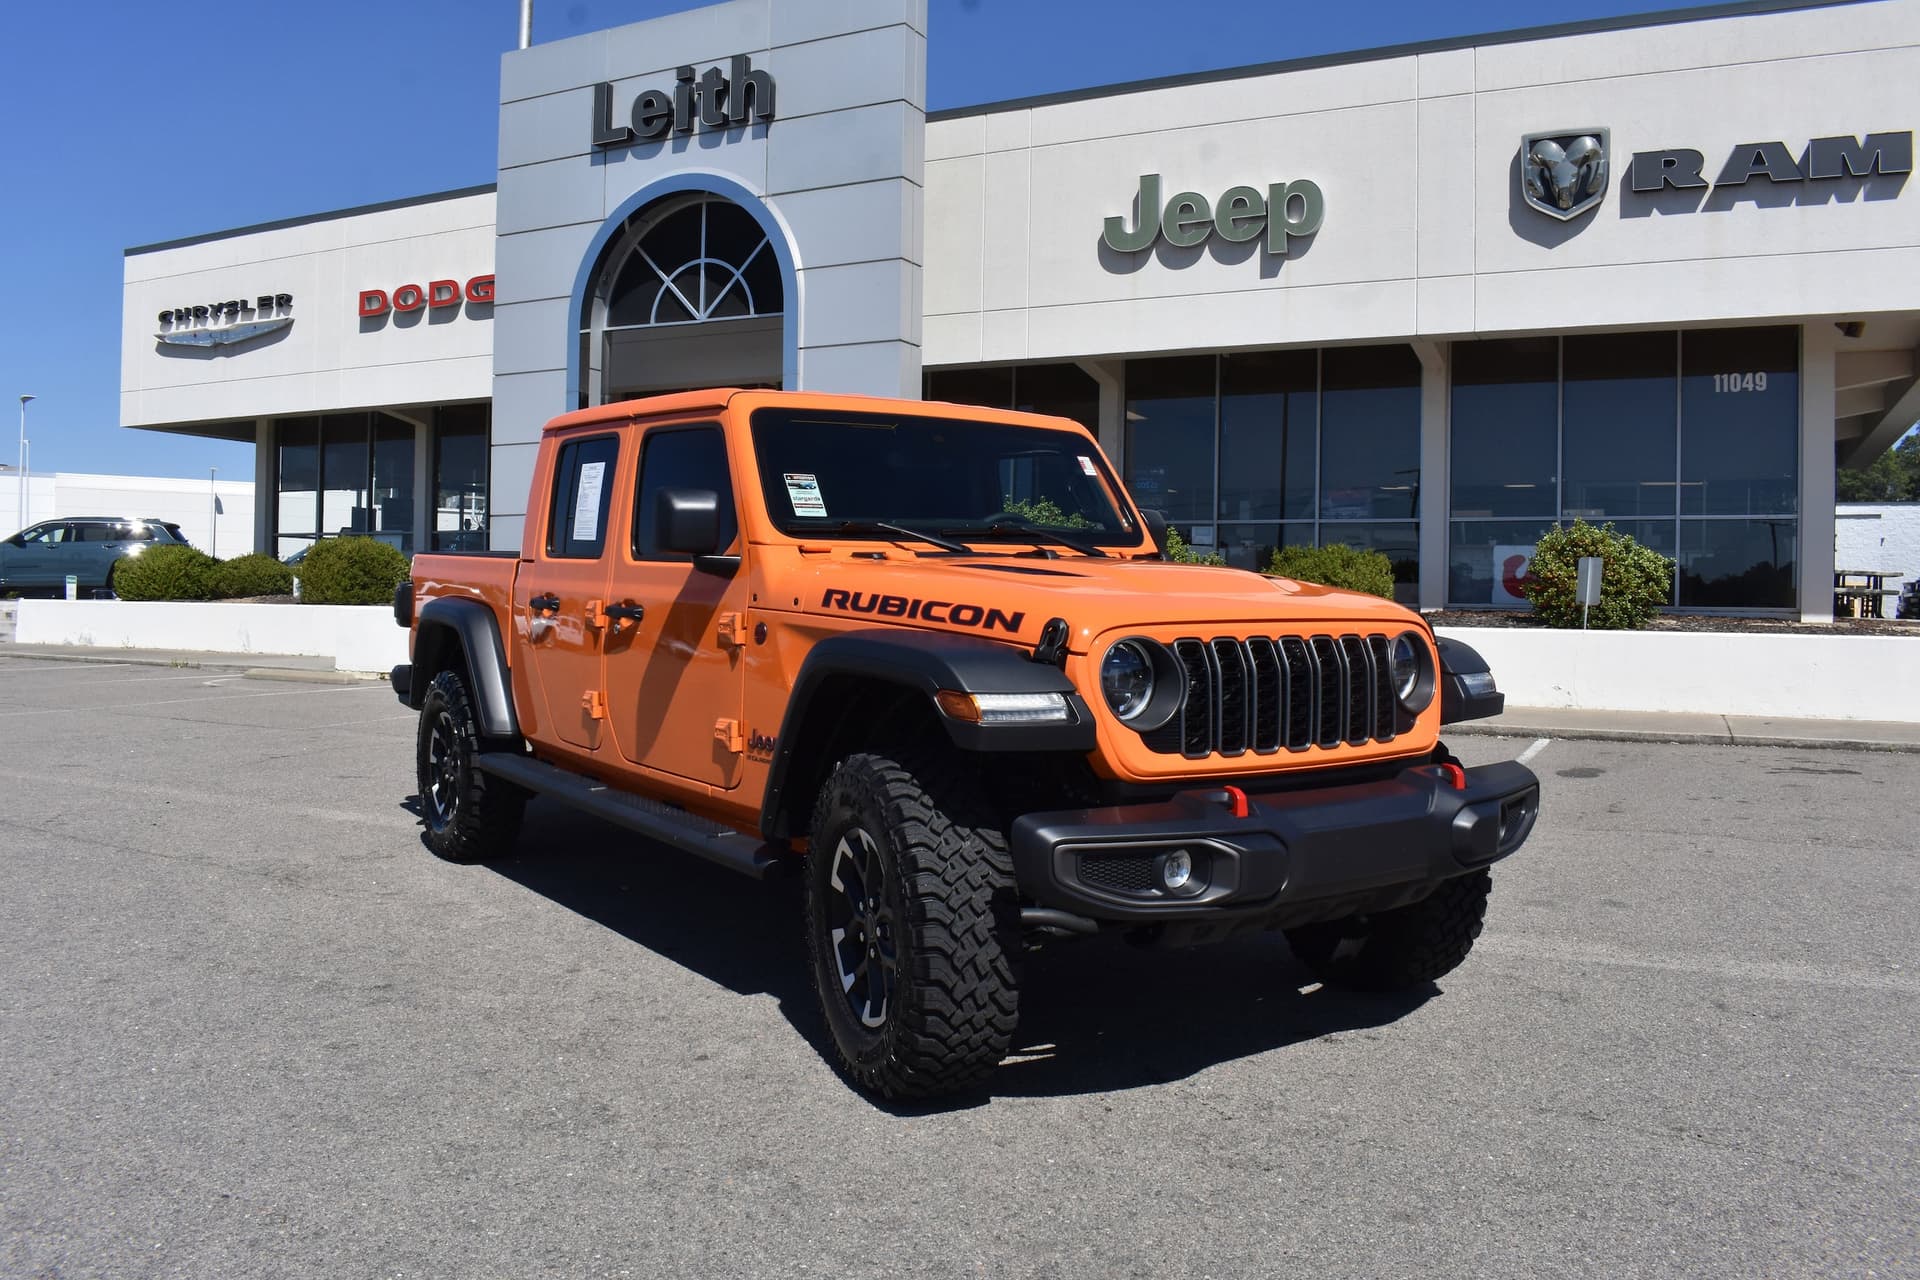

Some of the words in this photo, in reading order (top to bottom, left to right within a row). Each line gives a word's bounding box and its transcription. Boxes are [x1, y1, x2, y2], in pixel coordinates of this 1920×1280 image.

[592, 54, 775, 145] Leith
[1631, 130, 1914, 192] RAM
[1103, 174, 1324, 254] Jeep
[158, 293, 293, 323] CHRYSLER
[359, 274, 495, 317] DODG
[1713, 371, 1767, 393] 11049
[821, 588, 1026, 634] RUBICON
[748, 728, 777, 752] Jee
